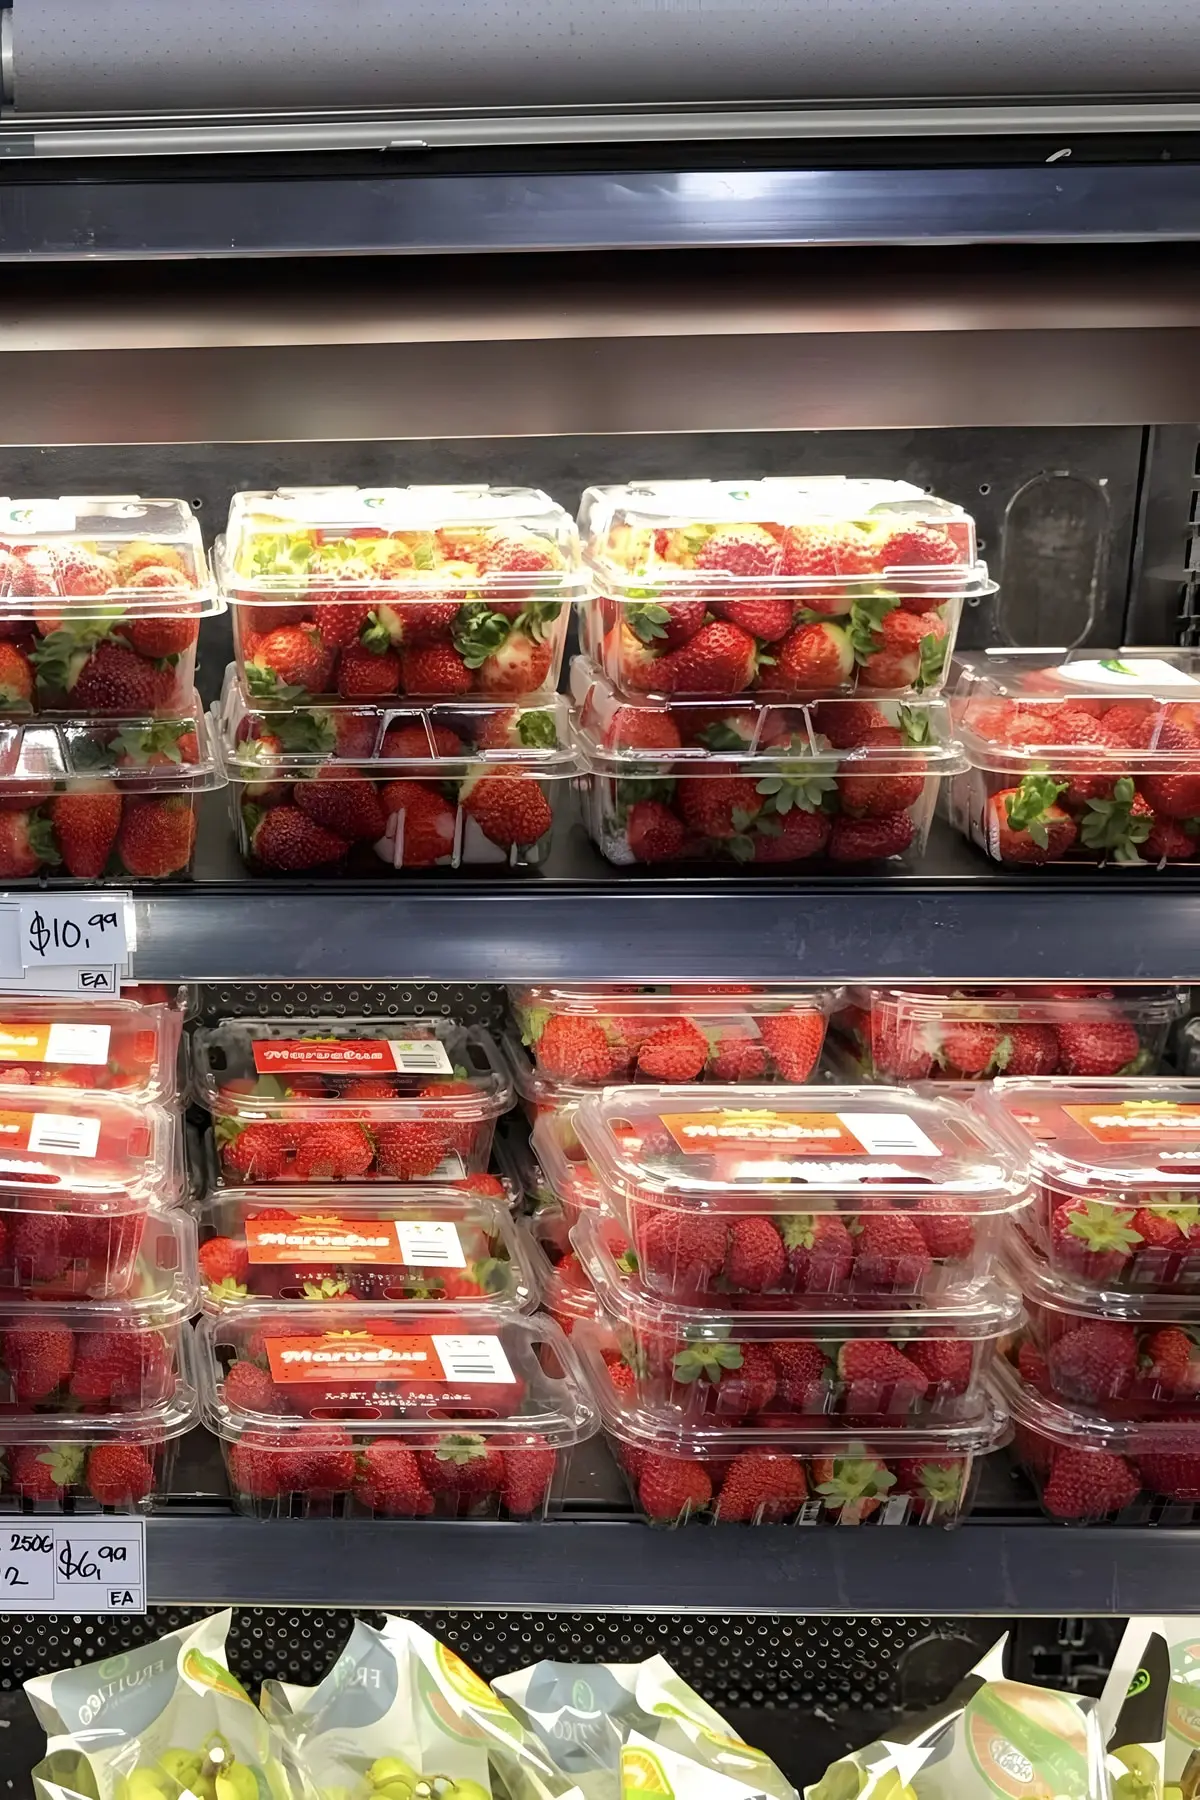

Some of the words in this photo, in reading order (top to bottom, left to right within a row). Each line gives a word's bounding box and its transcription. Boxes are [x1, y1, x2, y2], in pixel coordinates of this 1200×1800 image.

[81, 975, 108, 988] EA
[256, 1231, 391, 1249] Marvelus
[279, 1347, 428, 1364] Marvelus
[10, 1534, 53, 1552] 250G
[110, 1592, 134, 1606] EA
